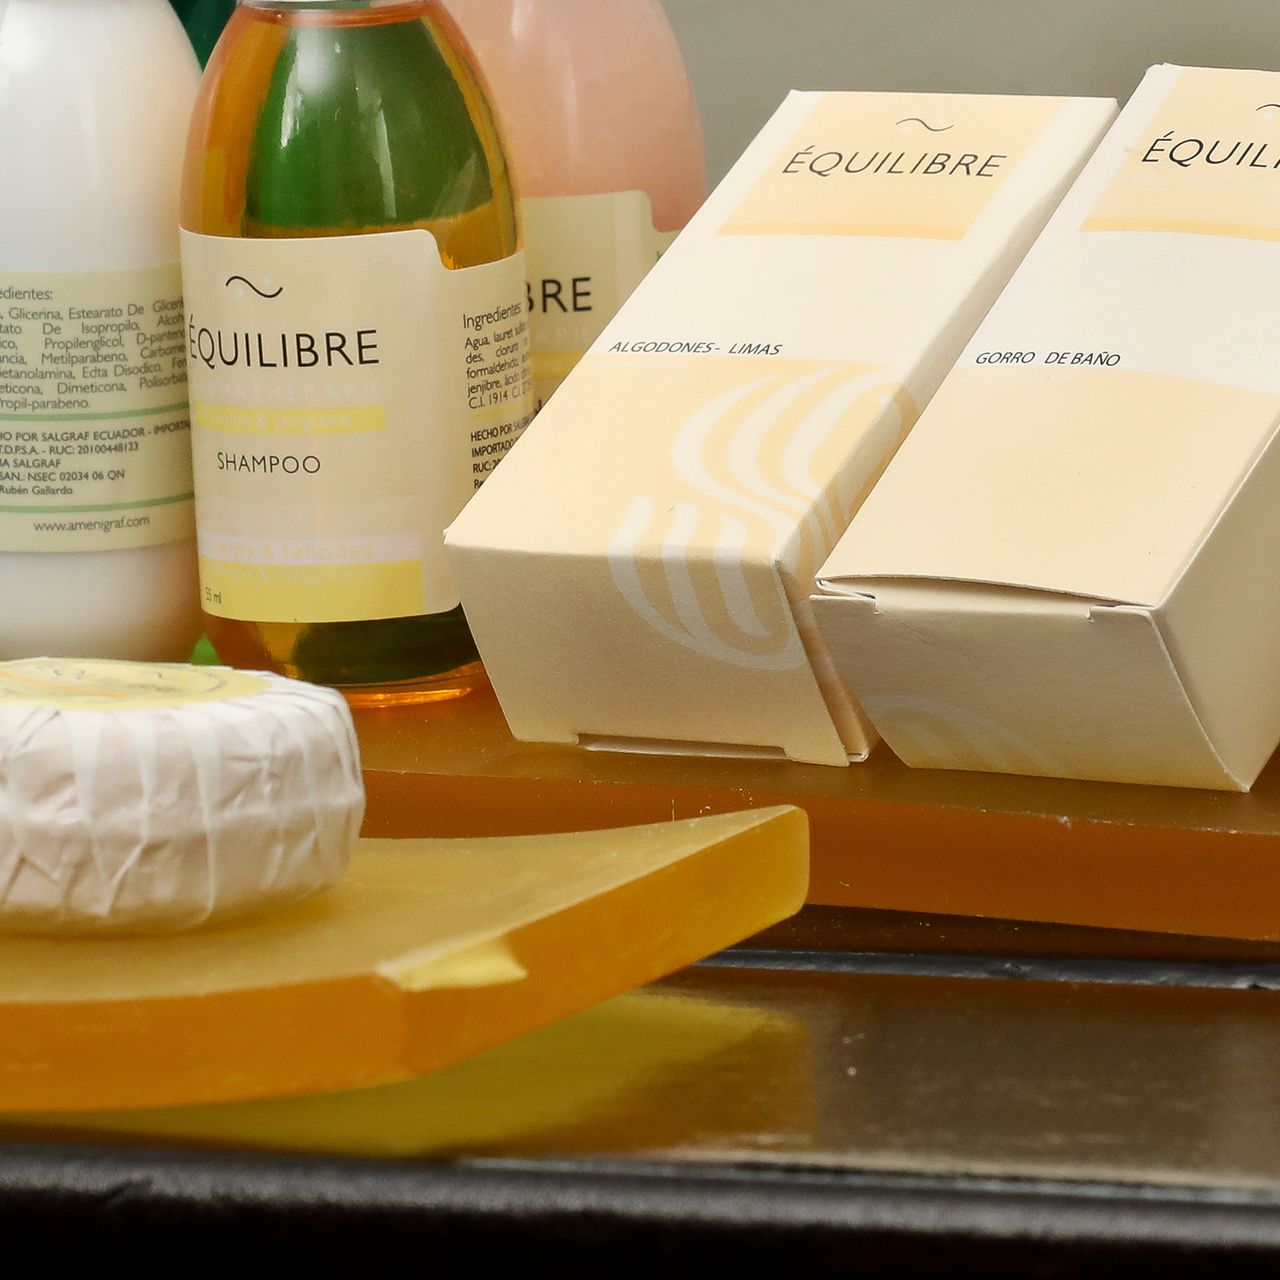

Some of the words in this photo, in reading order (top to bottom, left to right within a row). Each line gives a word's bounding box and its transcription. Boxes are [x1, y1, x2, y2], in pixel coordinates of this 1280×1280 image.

[782, 145, 1007, 178] ÉQUILIBRE
[68, 307, 123, 320] Estearato
[127, 303, 144, 316] De
[42, 323, 61, 335] De
[189, 314, 380, 370] ÉQUILIBRE
[728, 343, 784, 356] LIMAS
[41, 352, 128, 367] Metilparabeno,
[975, 352, 1036, 365] GORRO
[1044, 352, 1070, 365] DE
[1070, 351, 1121, 367] BAÑO
[82, 366, 108, 379] Edta
[57, 382, 128, 395] Dimeticona,
[15, 432, 39, 441] POR
[41, 431, 91, 442] SALGRAF
[93, 428, 145, 440] ECUADOR
[470, 427, 499, 442] HECHO
[49, 445, 76, 455] RUC:
[13, 458, 62, 468] SALGRAF
[217, 451, 321, 474] SHAMPOO
[27, 471, 57, 481] NSEC
[59, 471, 89, 481] 02034
[92, 471, 104, 481] 06
[107, 469, 126, 481] QN
[31, 485, 74, 495] Gallardo
[33, 516, 151, 534] www.amenigraf.com
